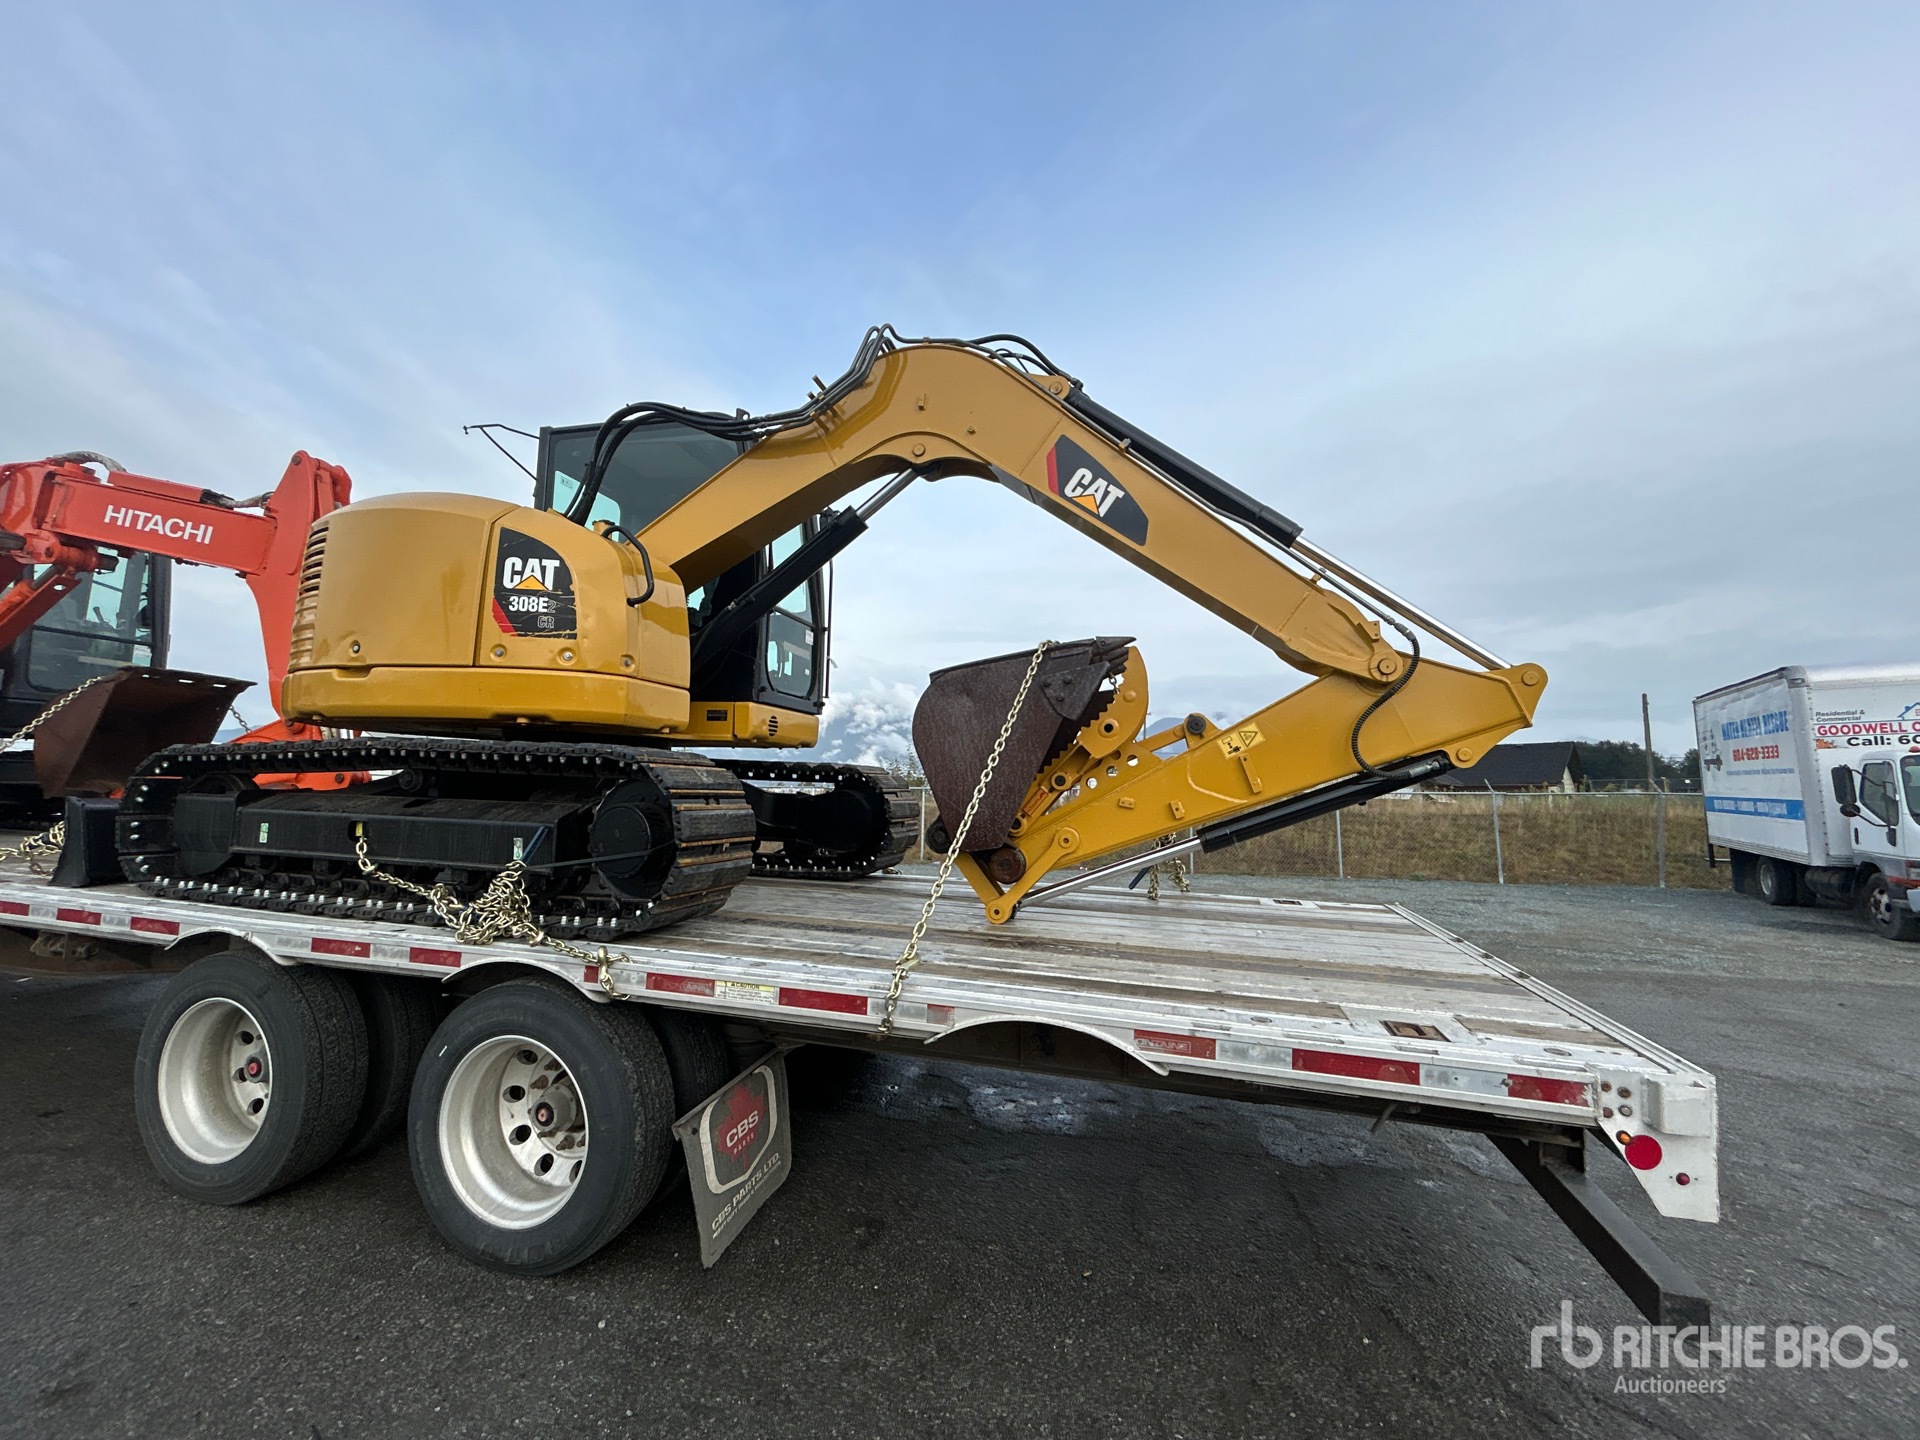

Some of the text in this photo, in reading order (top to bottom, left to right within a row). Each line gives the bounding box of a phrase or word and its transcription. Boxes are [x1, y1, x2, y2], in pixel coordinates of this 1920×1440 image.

[1064, 467, 1125, 518] CAT
[103, 504, 214, 545] HITACHI
[502, 556, 560, 591] CAT
[537, 615, 555, 629] CR
[1815, 715, 1862, 723] Commercial
[1817, 722, 1908, 736] GOODWELL
[1846, 735, 1892, 747] Call:
[726, 1110, 759, 1148] CBS
[733, 1132, 755, 1155] PARTS
[711, 1203, 731, 1231] CBS
[732, 1169, 762, 1207] PARTS
